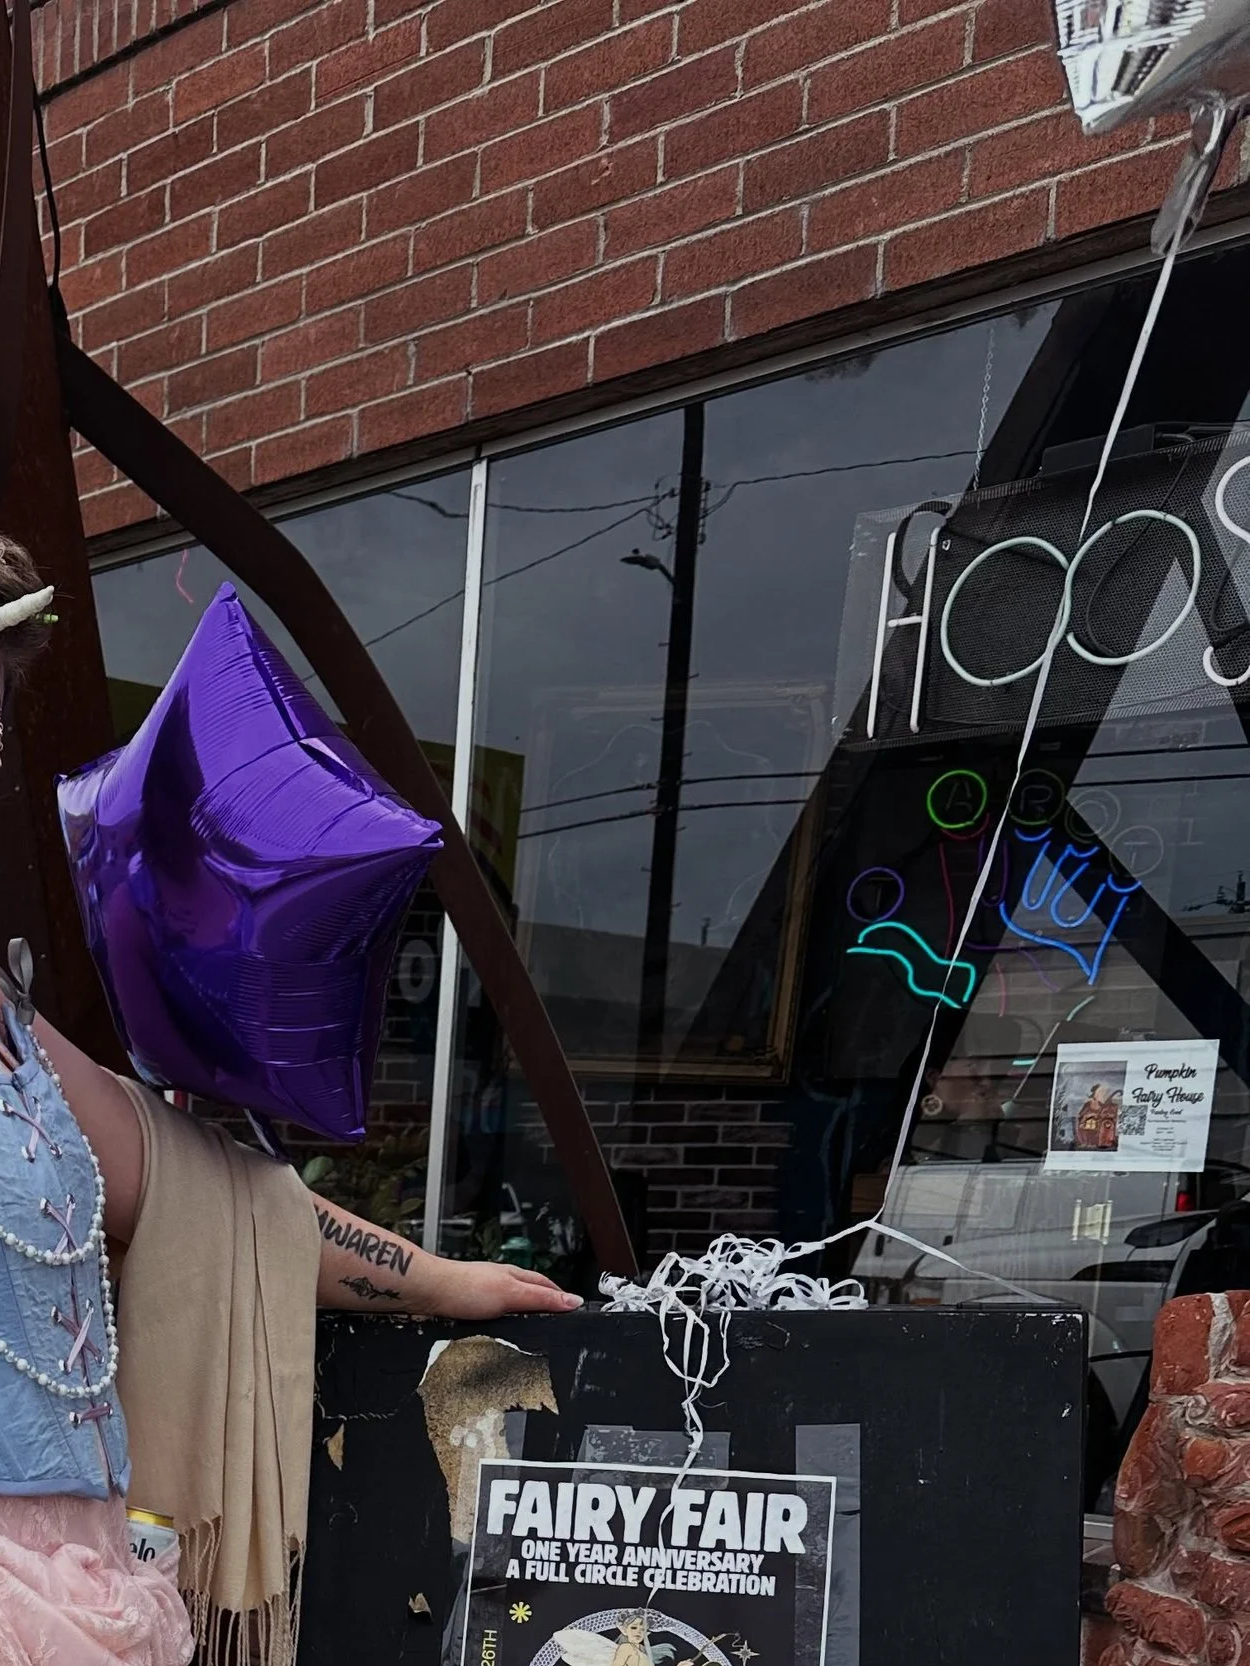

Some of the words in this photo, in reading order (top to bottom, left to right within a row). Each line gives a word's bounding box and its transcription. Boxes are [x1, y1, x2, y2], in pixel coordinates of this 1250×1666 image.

[1144, 1062, 1198, 1083] Pumpkin
[1131, 1087, 1164, 1108] Fairy
[1166, 1086, 1204, 1105] House
[487, 1479, 657, 1544] FAIRY
[670, 1489, 808, 1554] FAIR
[521, 1539, 562, 1562] ONE
[566, 1542, 618, 1565] YEAR
[622, 1546, 765, 1574] ANNIVERSARY
[506, 1558, 520, 1579] A
[525, 1560, 570, 1583] FULL
[574, 1564, 639, 1588] CIRCLE
[643, 1568, 776, 1597] CELEBRATION
